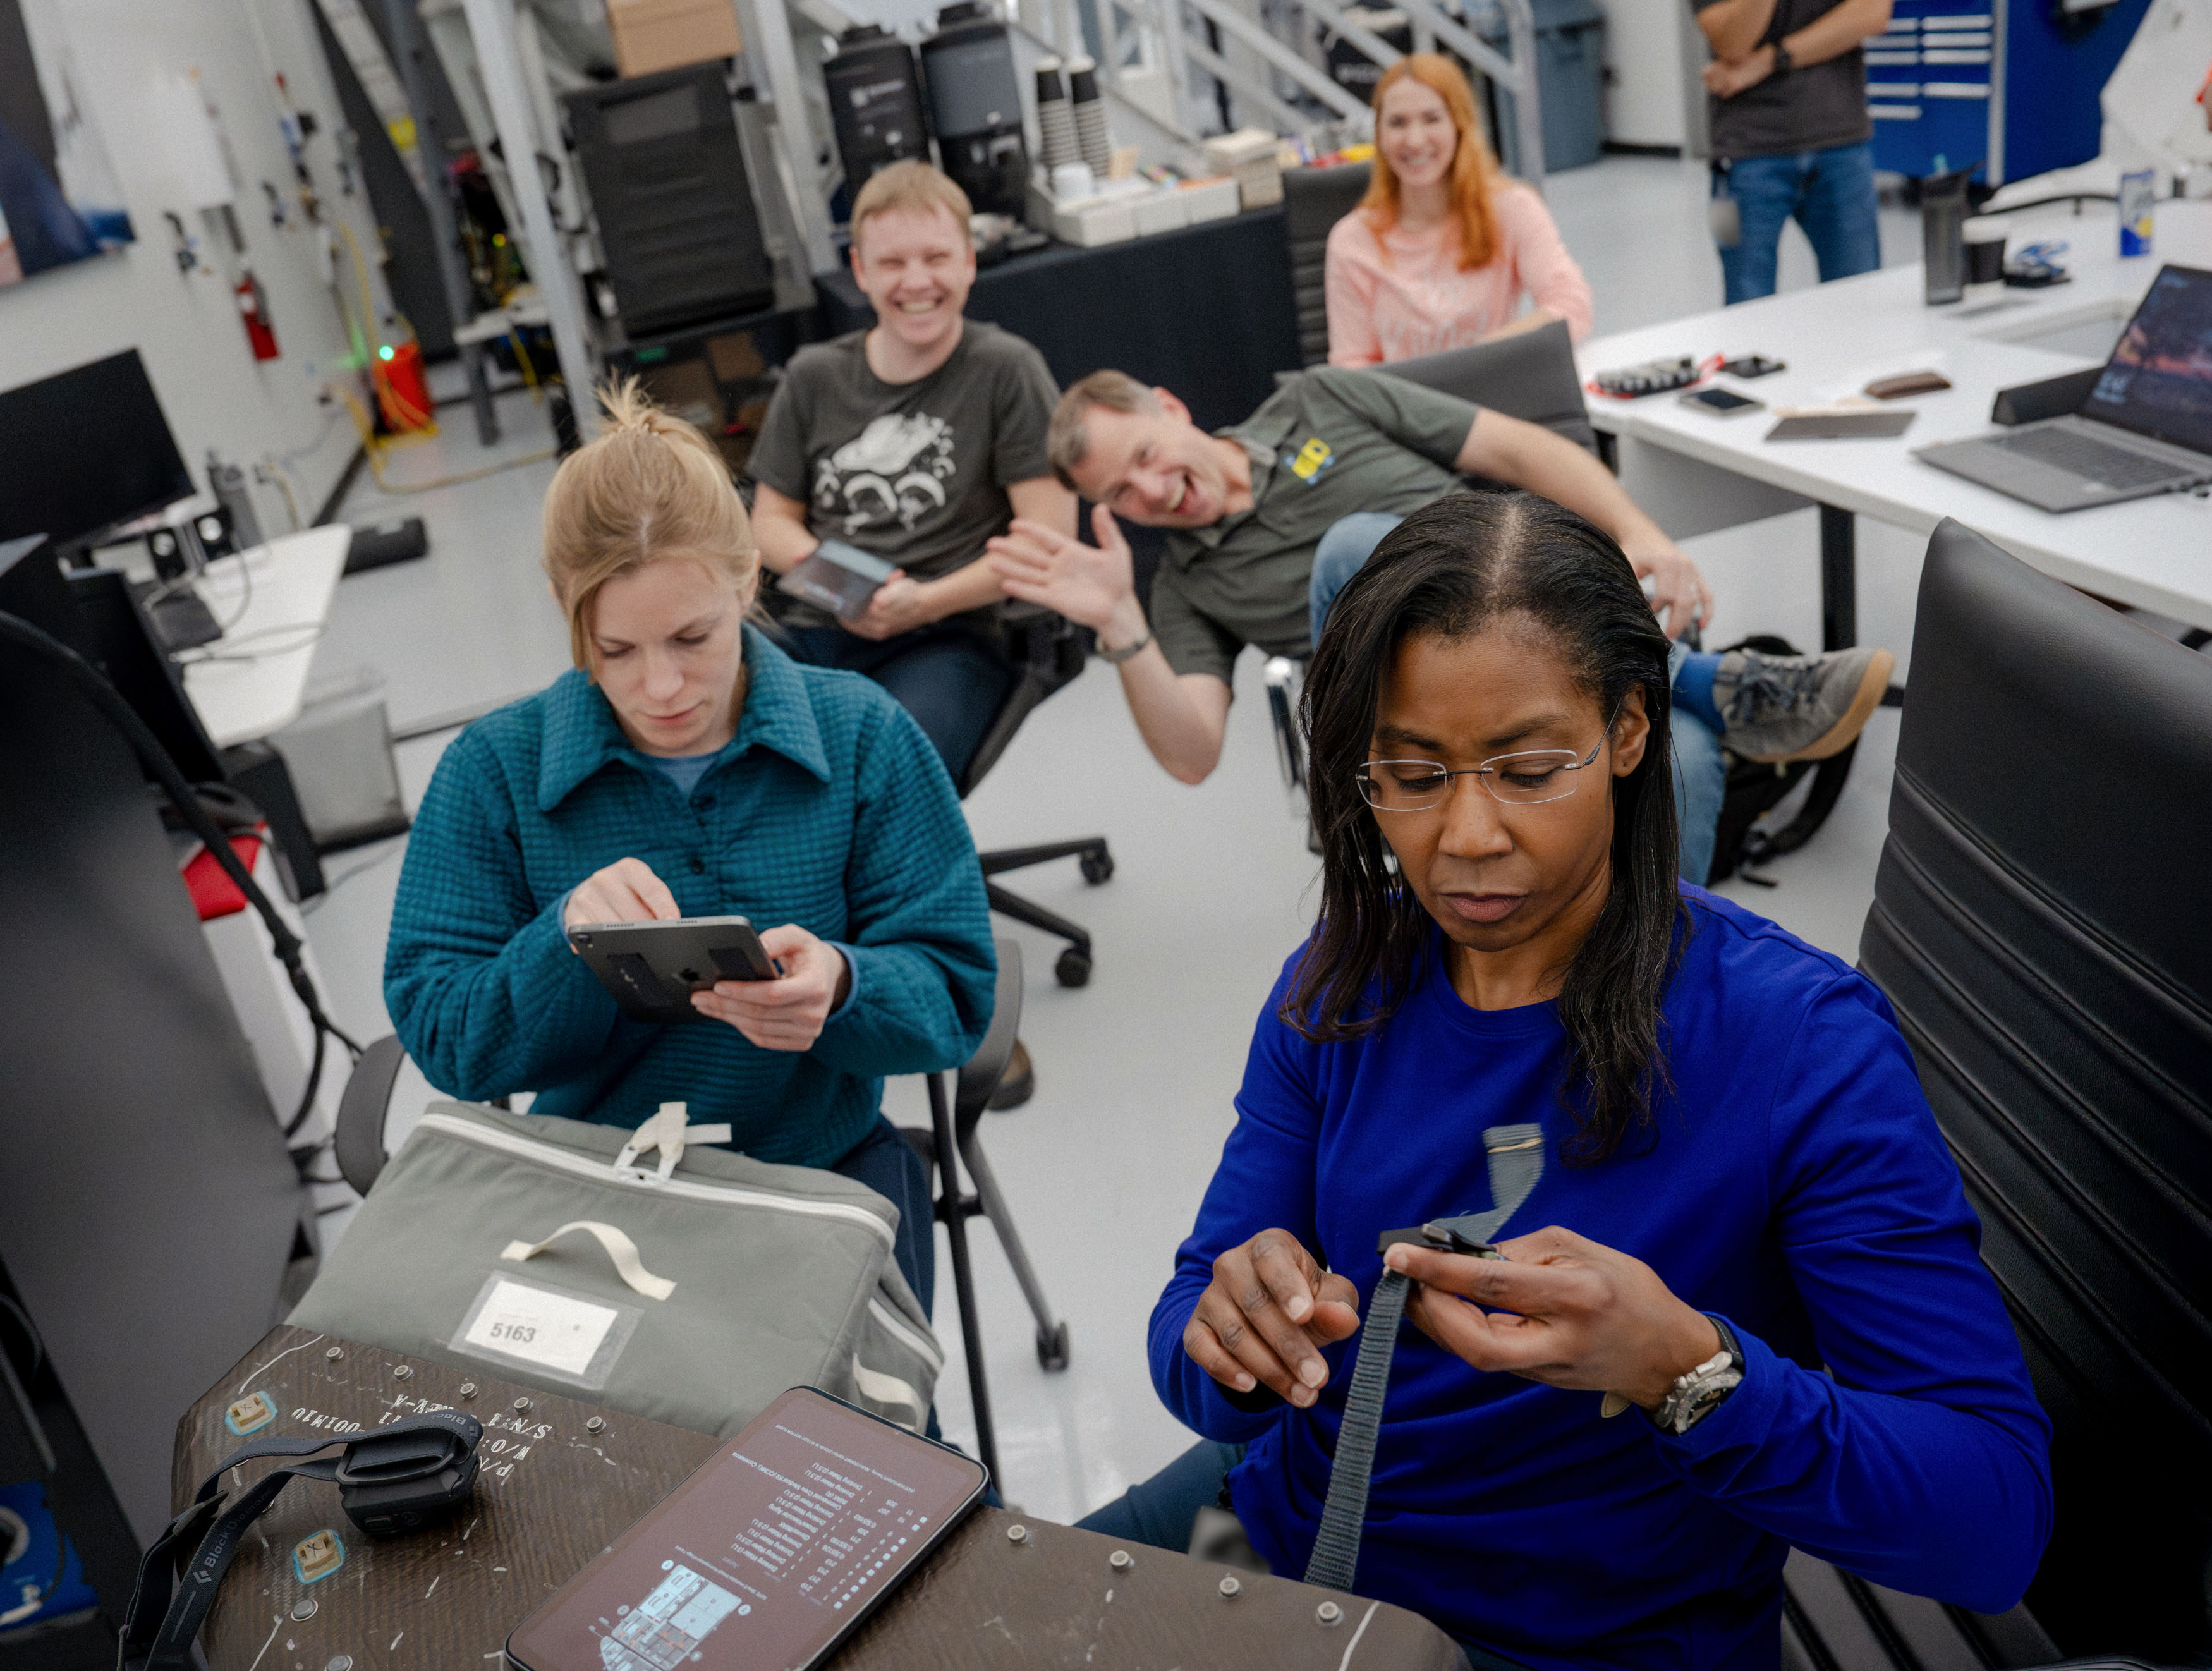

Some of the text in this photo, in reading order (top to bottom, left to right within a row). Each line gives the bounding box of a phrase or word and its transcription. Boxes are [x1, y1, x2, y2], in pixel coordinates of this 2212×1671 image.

[490, 1322, 536, 1343] 5163
[828, 1471, 842, 1481] Water
[820, 1478, 835, 1488] Water
[842, 1477, 863, 1490] Drinking
[835, 1485, 855, 1498] Drinking
[799, 1498, 814, 1507] Water
[791, 1505, 806, 1515] Water
[813, 1504, 834, 1518] Drinking
[806, 1511, 826, 1526] Drinking
[767, 1528, 782, 1538] Water
[759, 1535, 774, 1545] Water
[781, 1534, 802, 1548] Drinking
[204, 1531, 233, 1568] Black
[751, 1543, 766, 1553] Water
[774, 1541, 794, 1557] Drinking
[743, 1551, 758, 1561] Water
[763, 1549, 786, 1564] Drinking
[757, 1557, 778, 1572] Drinking
